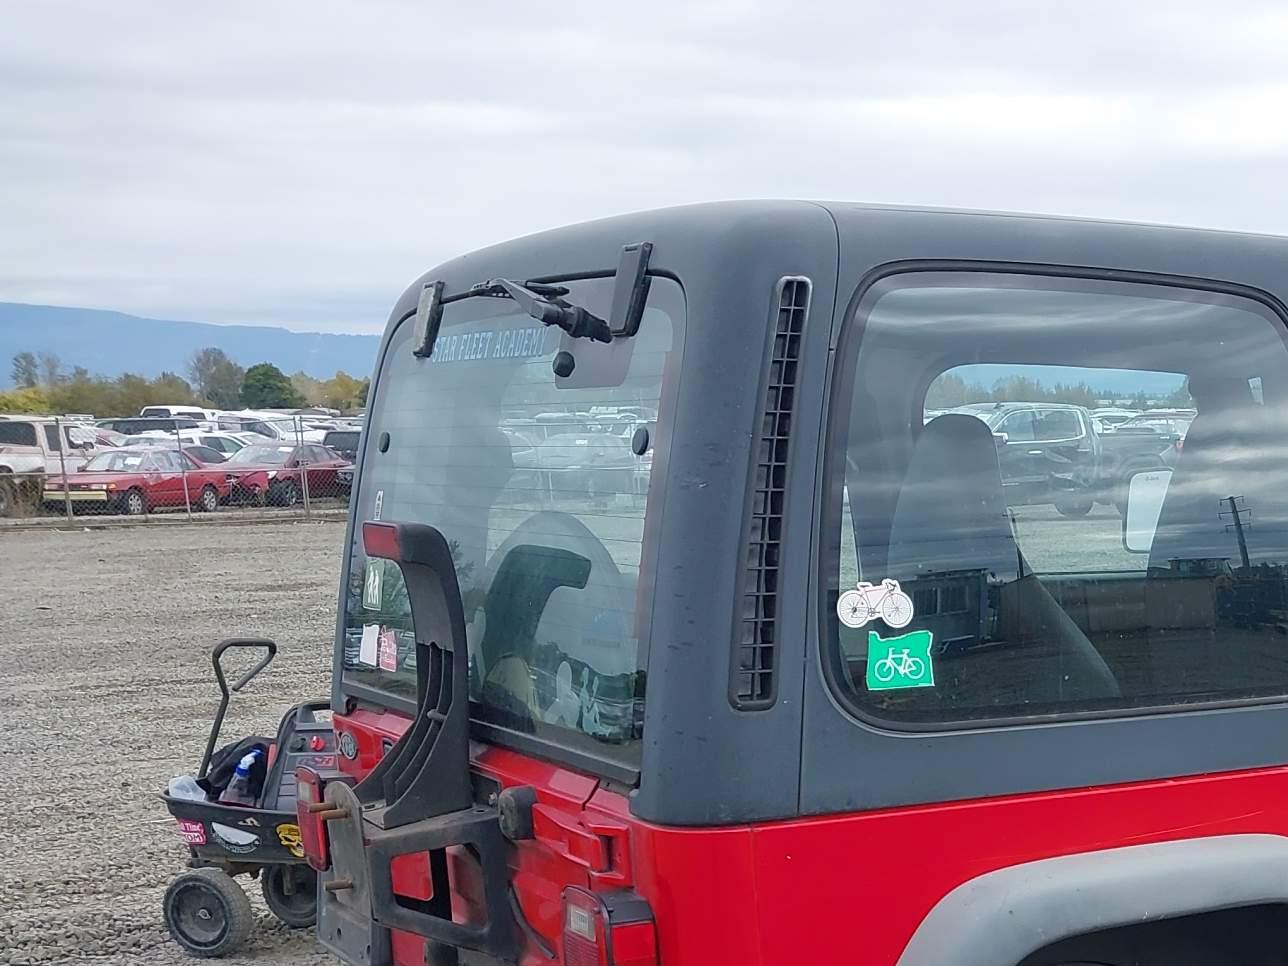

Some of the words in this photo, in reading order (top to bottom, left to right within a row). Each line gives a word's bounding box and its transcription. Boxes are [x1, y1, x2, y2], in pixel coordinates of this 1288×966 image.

[433, 336, 458, 362] STAR
[459, 332, 493, 360] FLEET
[493, 328, 548, 358] ACADEMY
